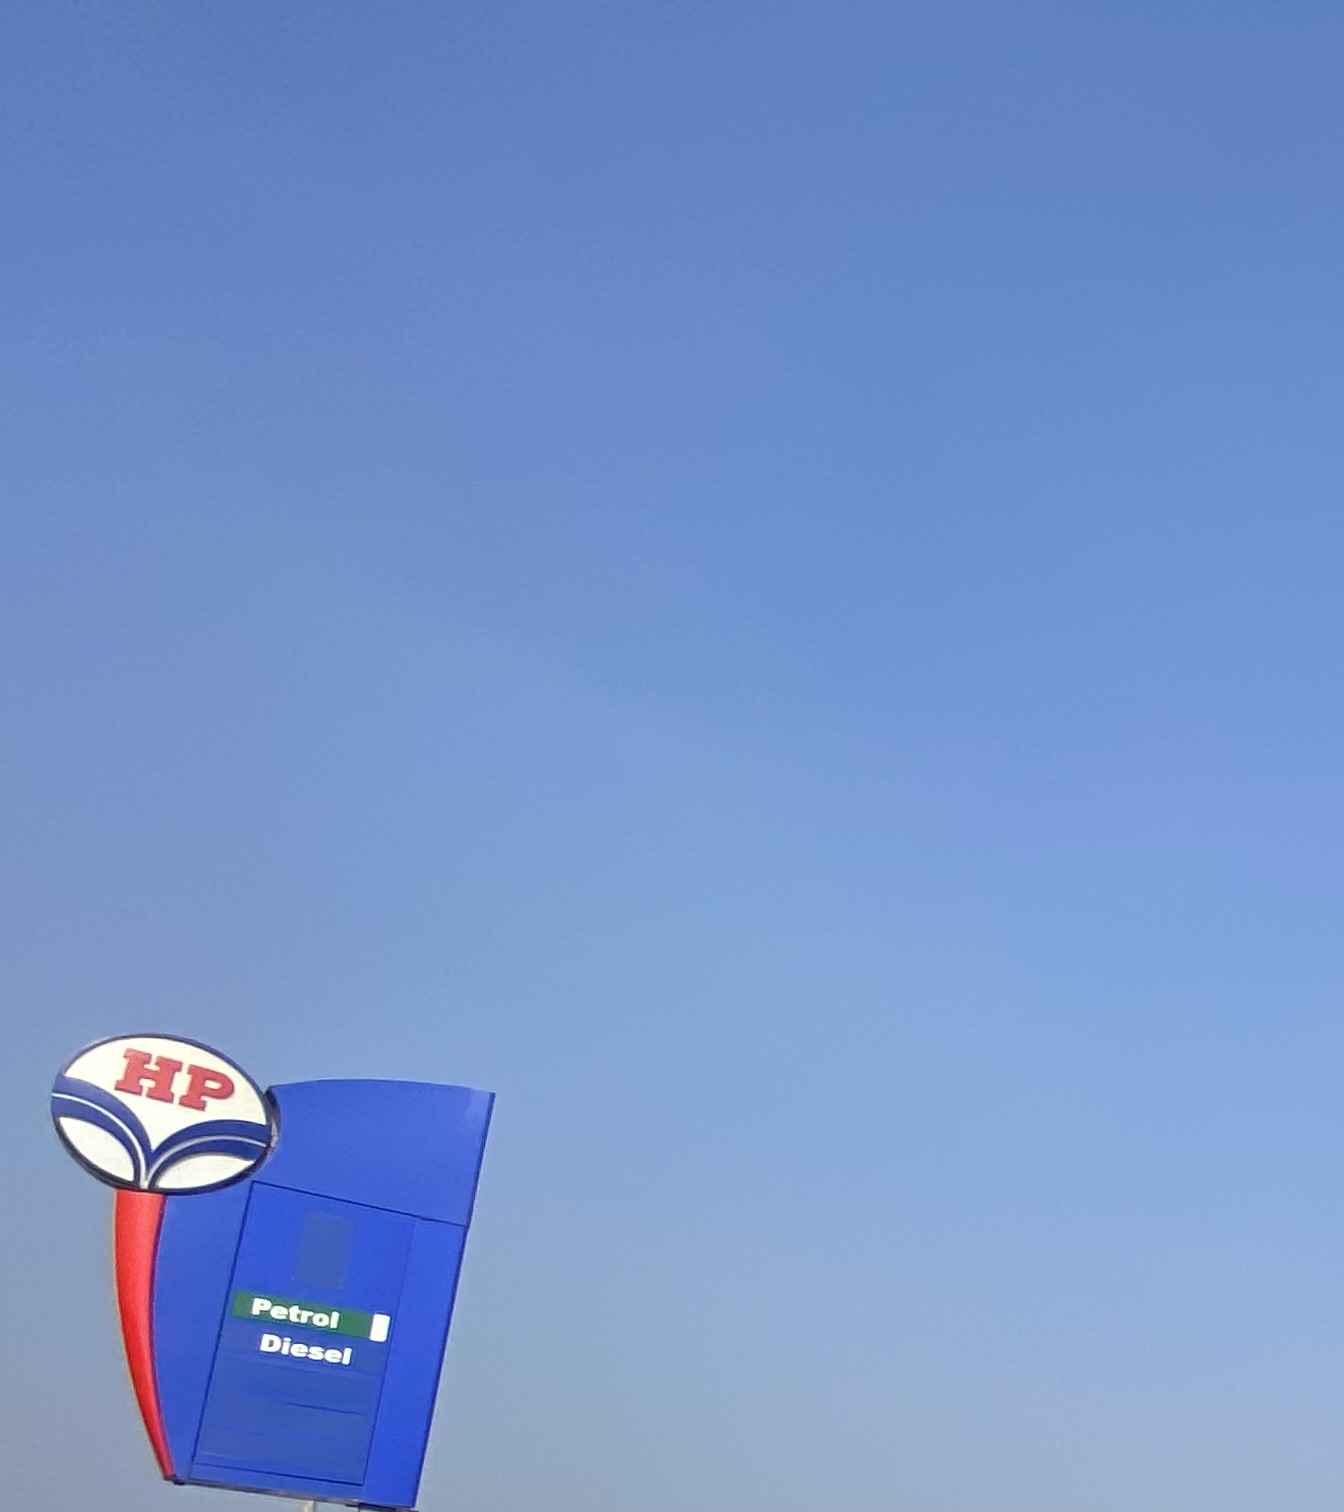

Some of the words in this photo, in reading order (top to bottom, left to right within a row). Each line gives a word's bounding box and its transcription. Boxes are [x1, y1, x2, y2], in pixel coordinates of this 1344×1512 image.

[114, 1047, 235, 1112] HP
[252, 1297, 340, 1329] Petrol
[260, 1333, 353, 1366] Diesel
